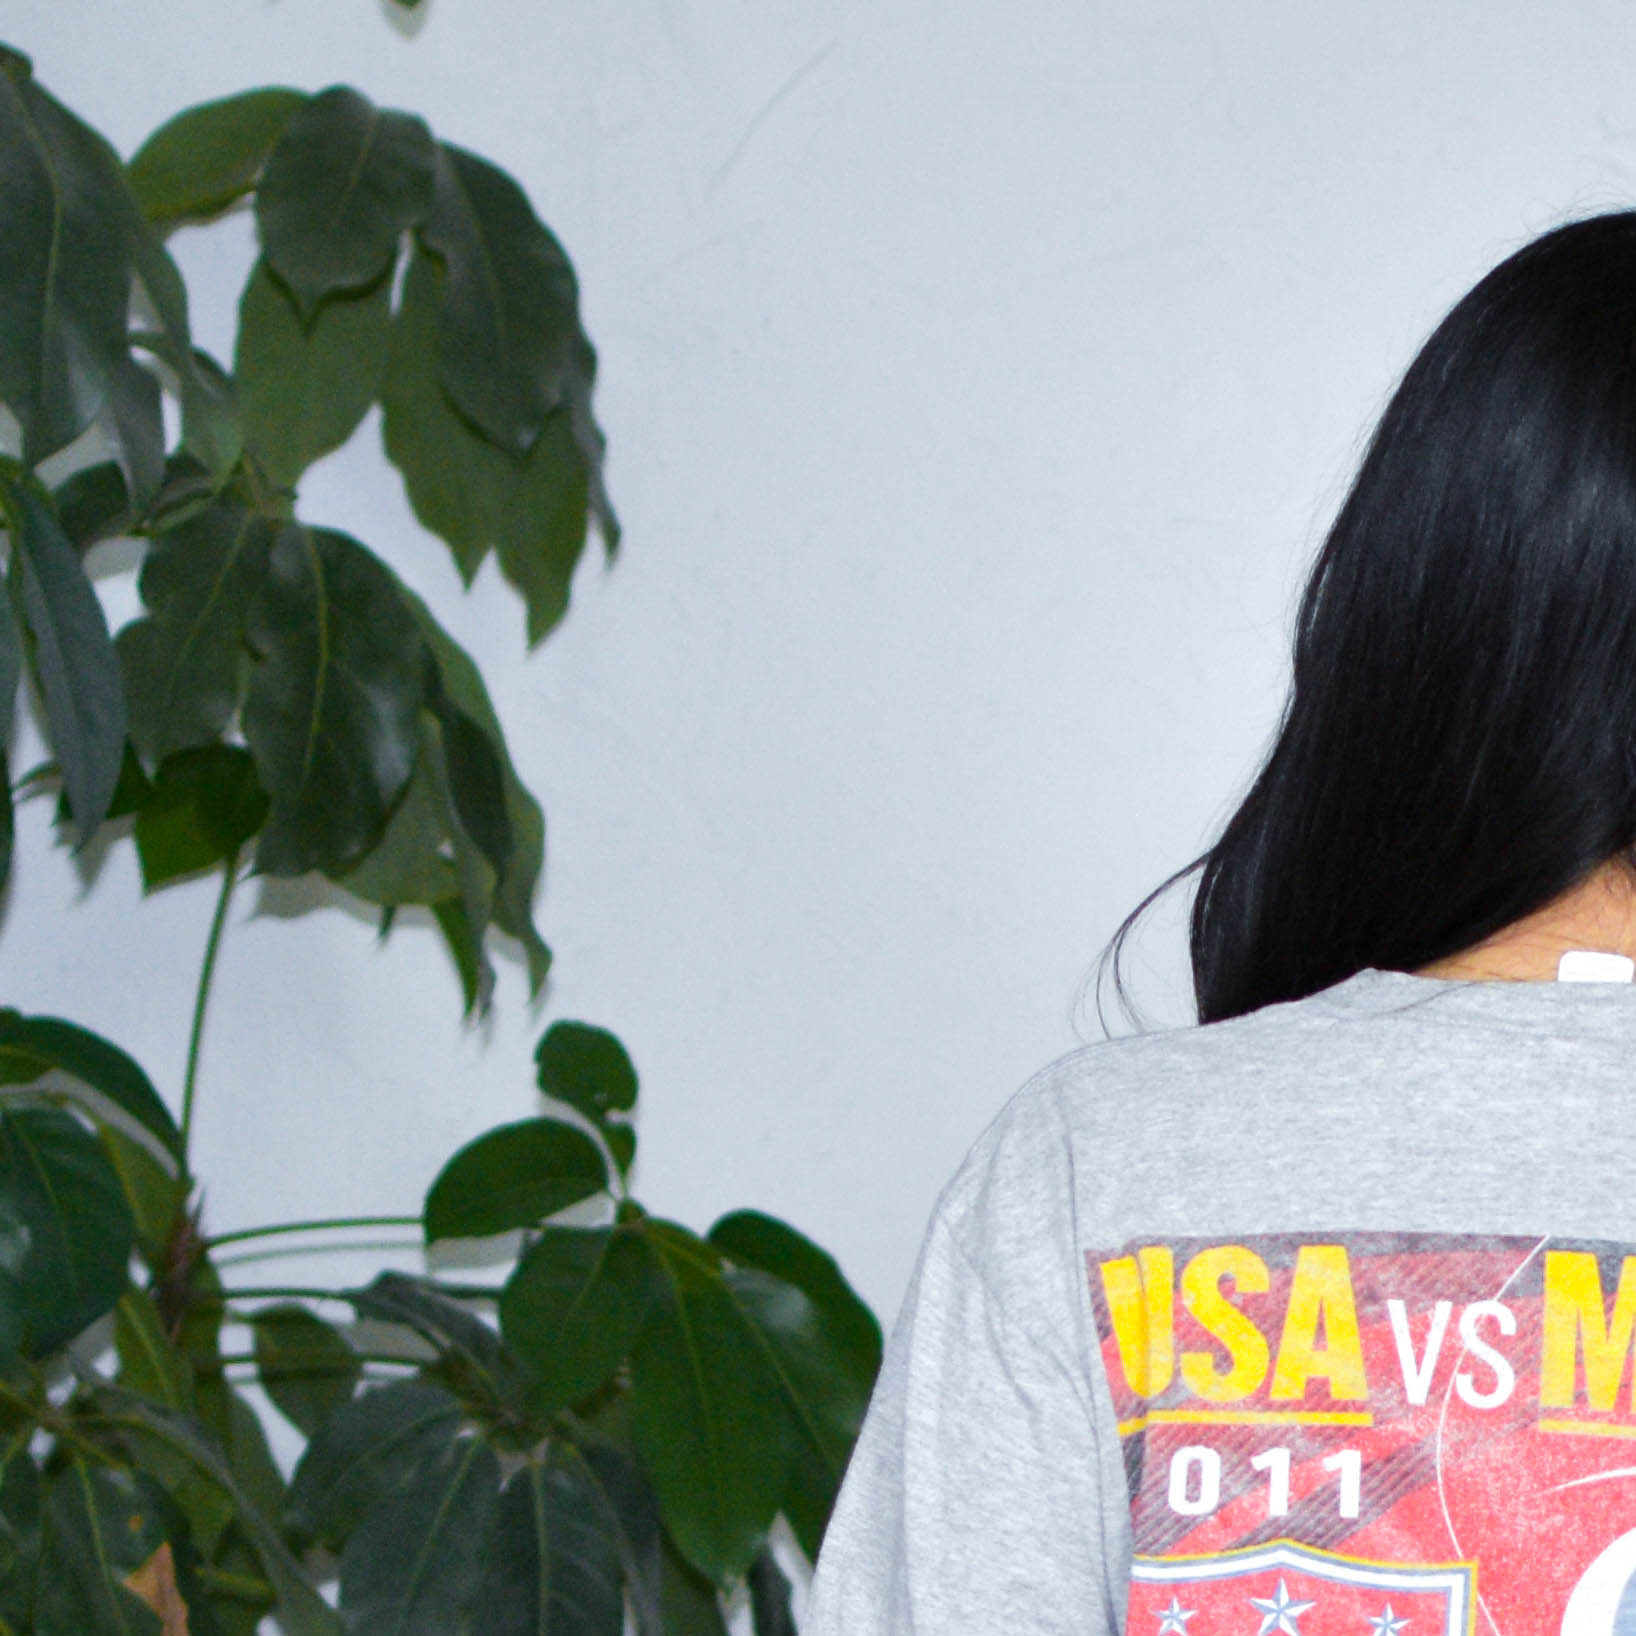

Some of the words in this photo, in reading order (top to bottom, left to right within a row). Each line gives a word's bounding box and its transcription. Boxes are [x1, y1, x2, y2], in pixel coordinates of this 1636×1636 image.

[1100, 1244, 1371, 1403] USA
[1387, 1298, 1518, 1410] VS
[1167, 1444, 1363, 1520] 011
